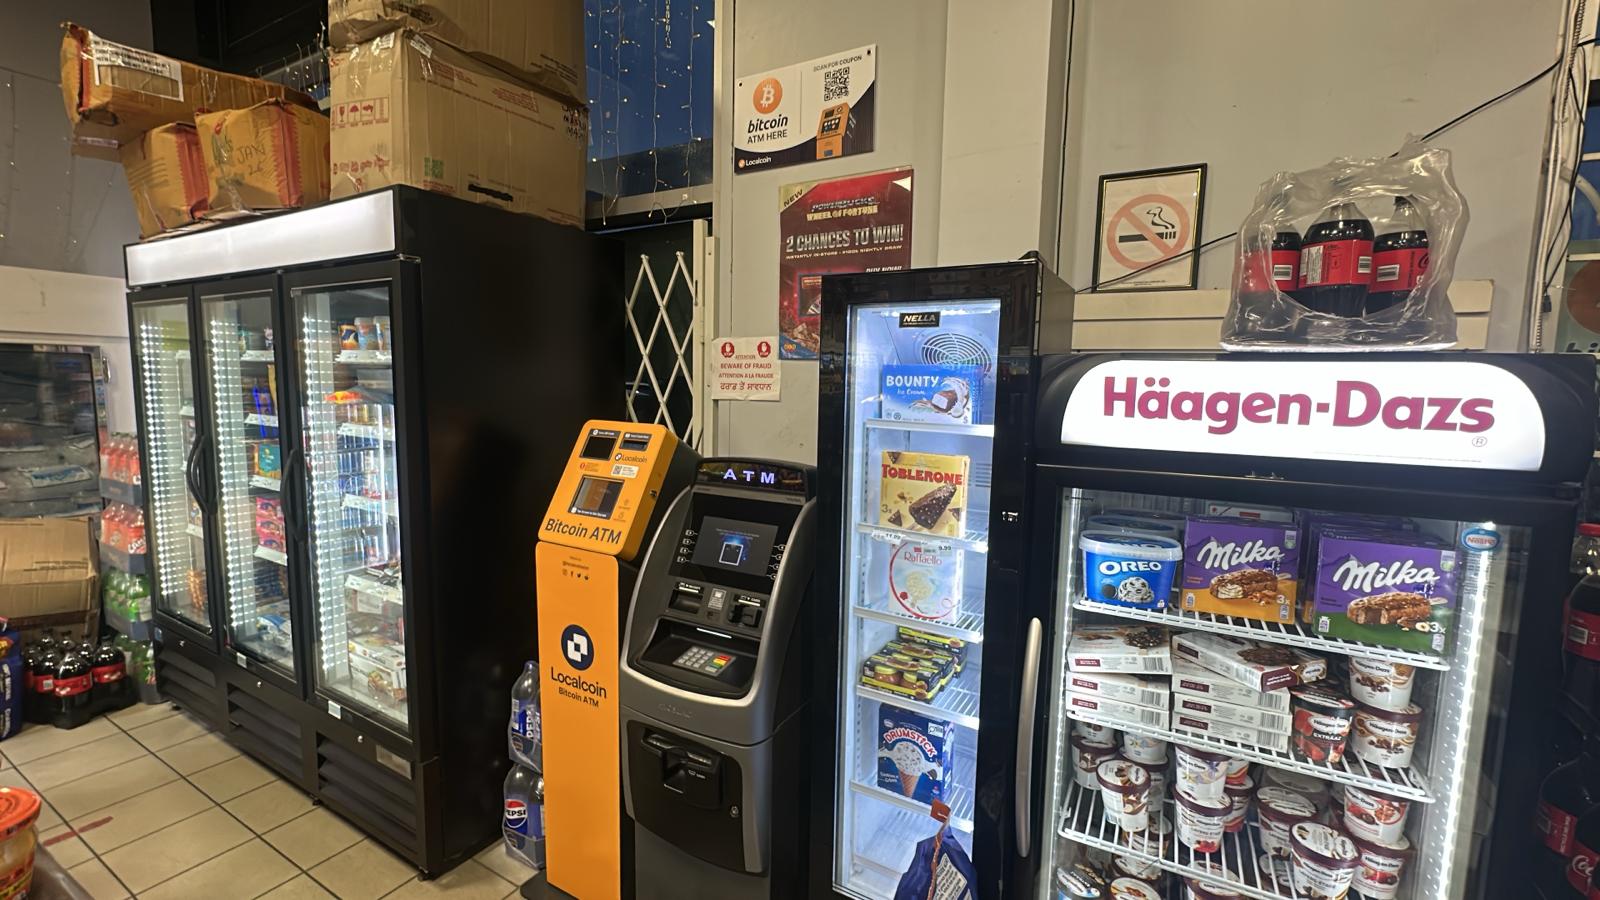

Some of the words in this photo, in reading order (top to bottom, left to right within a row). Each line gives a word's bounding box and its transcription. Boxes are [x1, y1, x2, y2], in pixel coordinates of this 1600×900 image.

[839, 55, 863, 65] COUPON
[747, 114, 788, 134] bitcoin
[747, 133, 765, 144] ATM
[766, 129, 788, 142] HERE
[745, 156, 772, 167] Localcoin
[783, 189, 803, 207] NEW
[806, 211, 832, 221] WHEEL
[842, 205, 878, 217] FORTUNE
[786, 235, 794, 252] 2
[796, 229, 851, 252] CHANCES
[853, 227, 870, 246] TO
[872, 223, 904, 244] WIN!
[903, 314, 936, 322] NELLA
[886, 375, 940, 387] BOUNTY
[1103, 376, 1496, 435] Häagen-Dazs
[621, 454, 648, 463] Localcoin
[723, 468, 775, 485] ATM
[881, 463, 963, 486] TOBLERONE
[544, 518, 588, 538] Bitcoin
[589, 523, 622, 544] ATM
[904, 551, 943, 566] Raffaello
[1196, 540, 1285, 571] Milka
[1099, 561, 1162, 575] OREO
[1332, 559, 1441, 593] Milka
[551, 666, 607, 699] Localcoin
[558, 687, 582, 703] Bitcoin
[583, 695, 599, 708] ATM
[884, 728, 937, 757] DRUMSTICK
